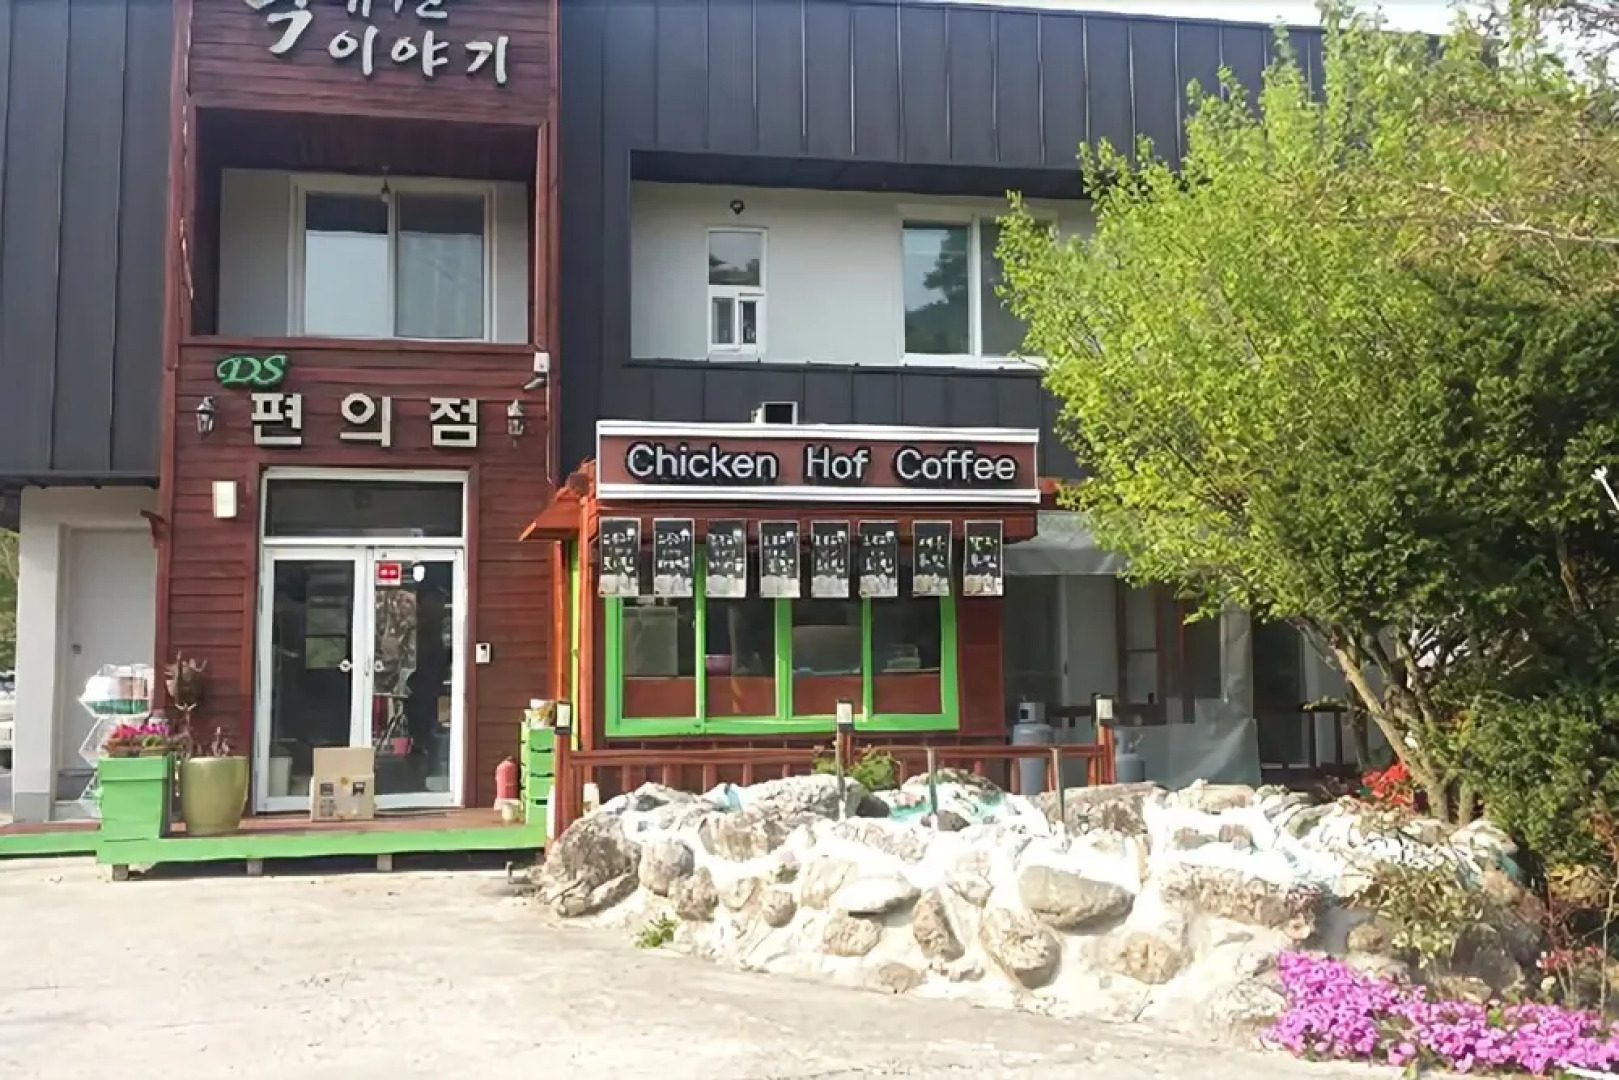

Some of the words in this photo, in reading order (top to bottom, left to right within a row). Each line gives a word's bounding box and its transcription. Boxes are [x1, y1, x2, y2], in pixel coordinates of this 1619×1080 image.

[328, 25, 509, 84] 이야기
[216, 354, 287, 385] DS
[251, 393, 478, 448] 편의점
[626, 443, 778, 479] Chicken
[806, 446, 869, 479] Hof
[896, 447, 1017, 481] Coffee
